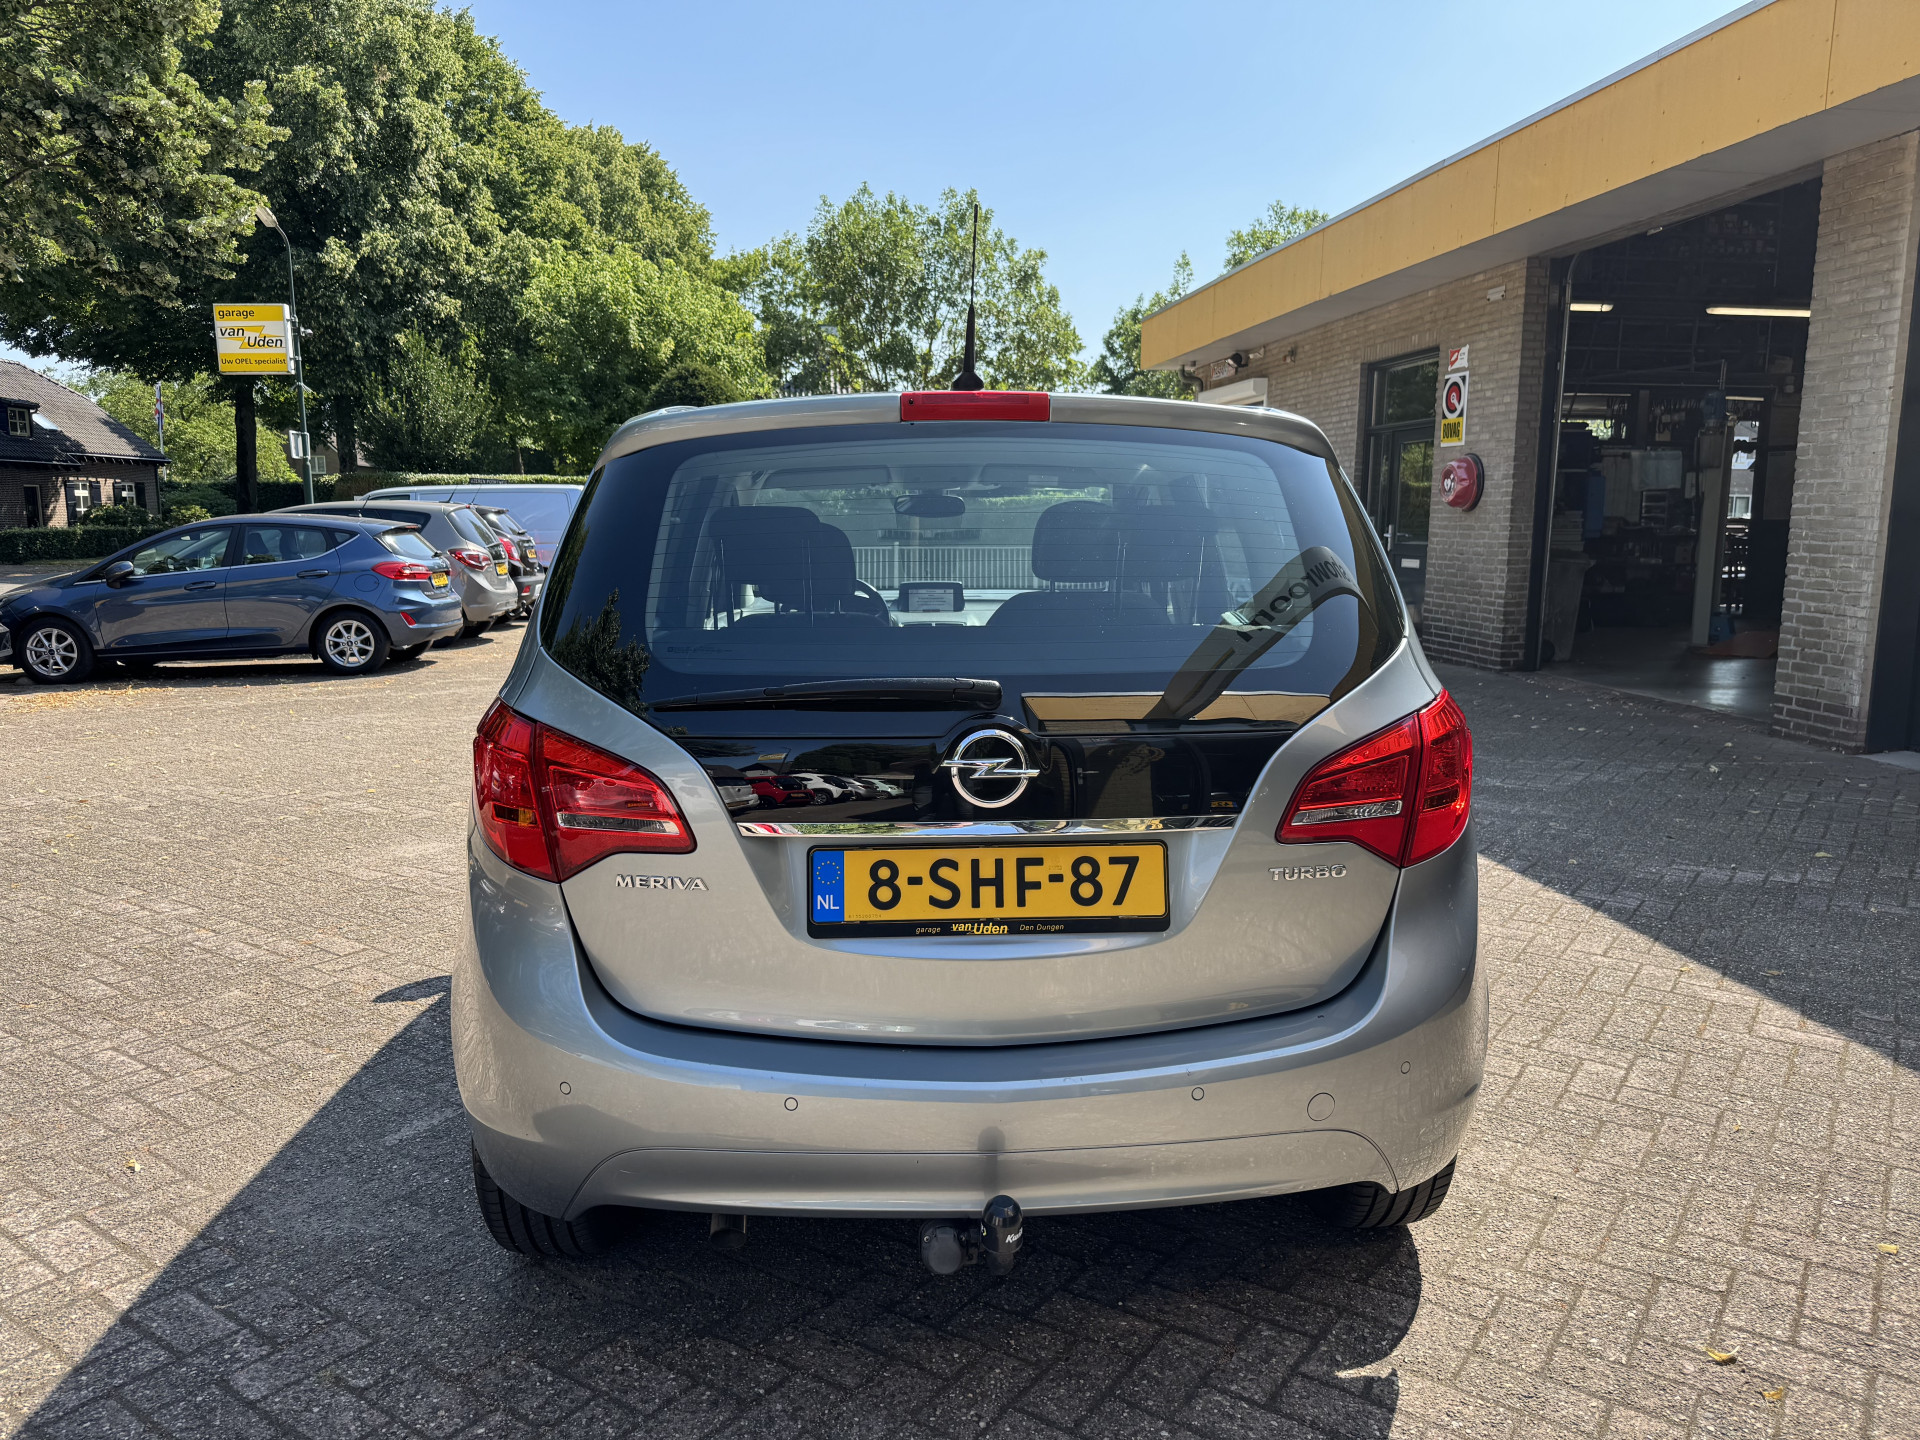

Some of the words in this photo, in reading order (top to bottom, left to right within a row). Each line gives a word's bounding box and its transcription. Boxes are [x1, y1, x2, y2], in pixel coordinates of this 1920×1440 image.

[218, 310, 255, 319] garage
[220, 327, 245, 337] van
[247, 336, 283, 347] Uden
[1442, 421, 1461, 439] BOVAG
[1268, 864, 1347, 881] TURBO
[615, 873, 710, 891] MERIVA
[868, 856, 1139, 910] 8-SHF-87
[817, 894, 840, 910] NL
[915, 926, 941, 934] garage
[952, 923, 972, 931] van
[973, 923, 1008, 934] Uden
[1036, 923, 1065, 932] Dungen
